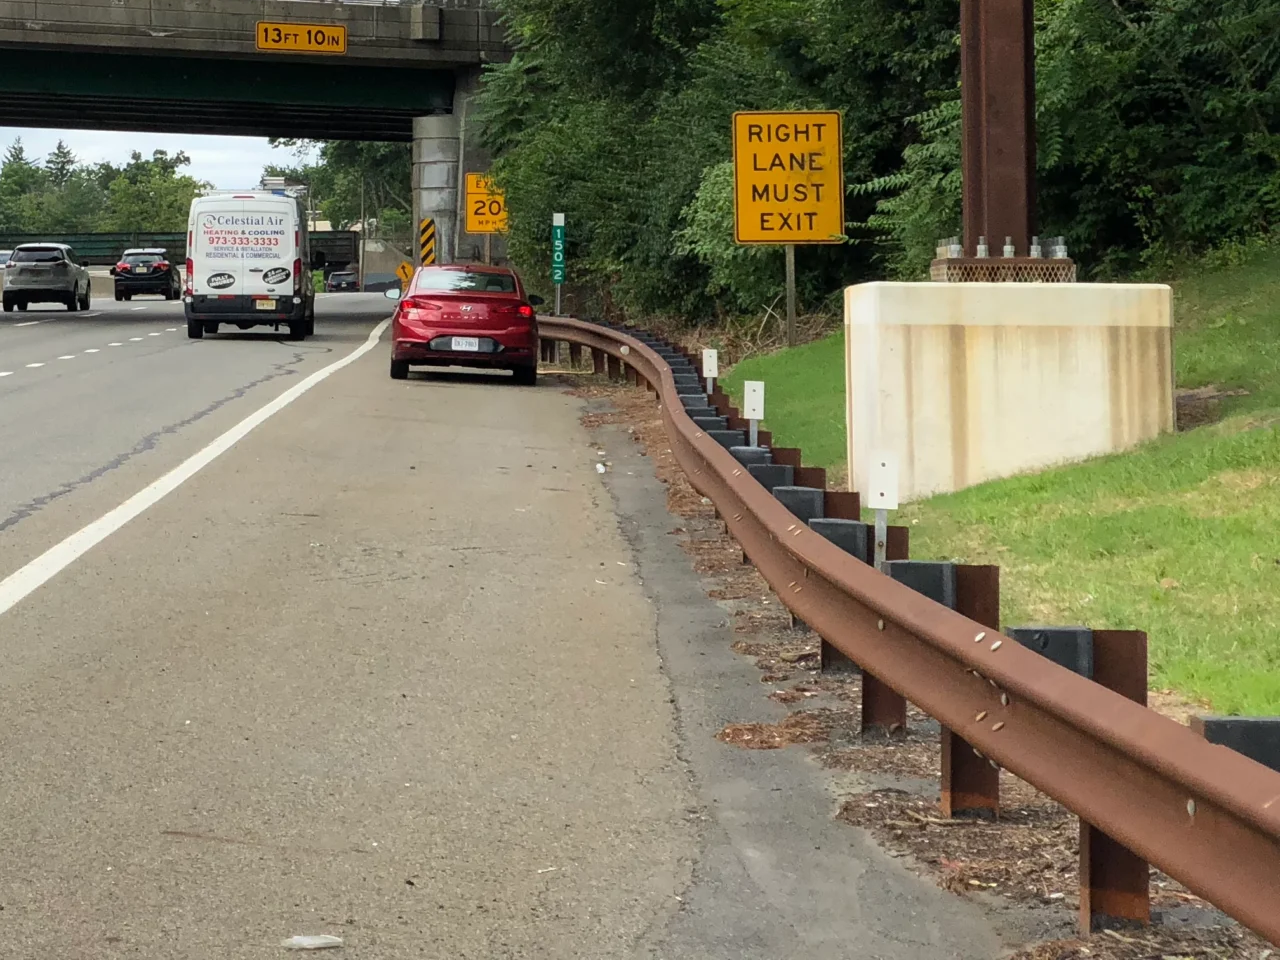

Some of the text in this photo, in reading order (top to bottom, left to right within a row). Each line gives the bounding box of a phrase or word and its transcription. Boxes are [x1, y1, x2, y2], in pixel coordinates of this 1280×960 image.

[748, 123, 826, 142] RIGHT
[753, 152, 824, 171] LANE
[751, 183, 825, 202] MUST
[473, 200, 502, 216] 20
[217, 215, 284, 226] Celestial Air
[760, 212, 818, 231] EXIT
[208, 236, 279, 246] 973-333-3333
[245, 252, 281, 260] COMMERCIAL
